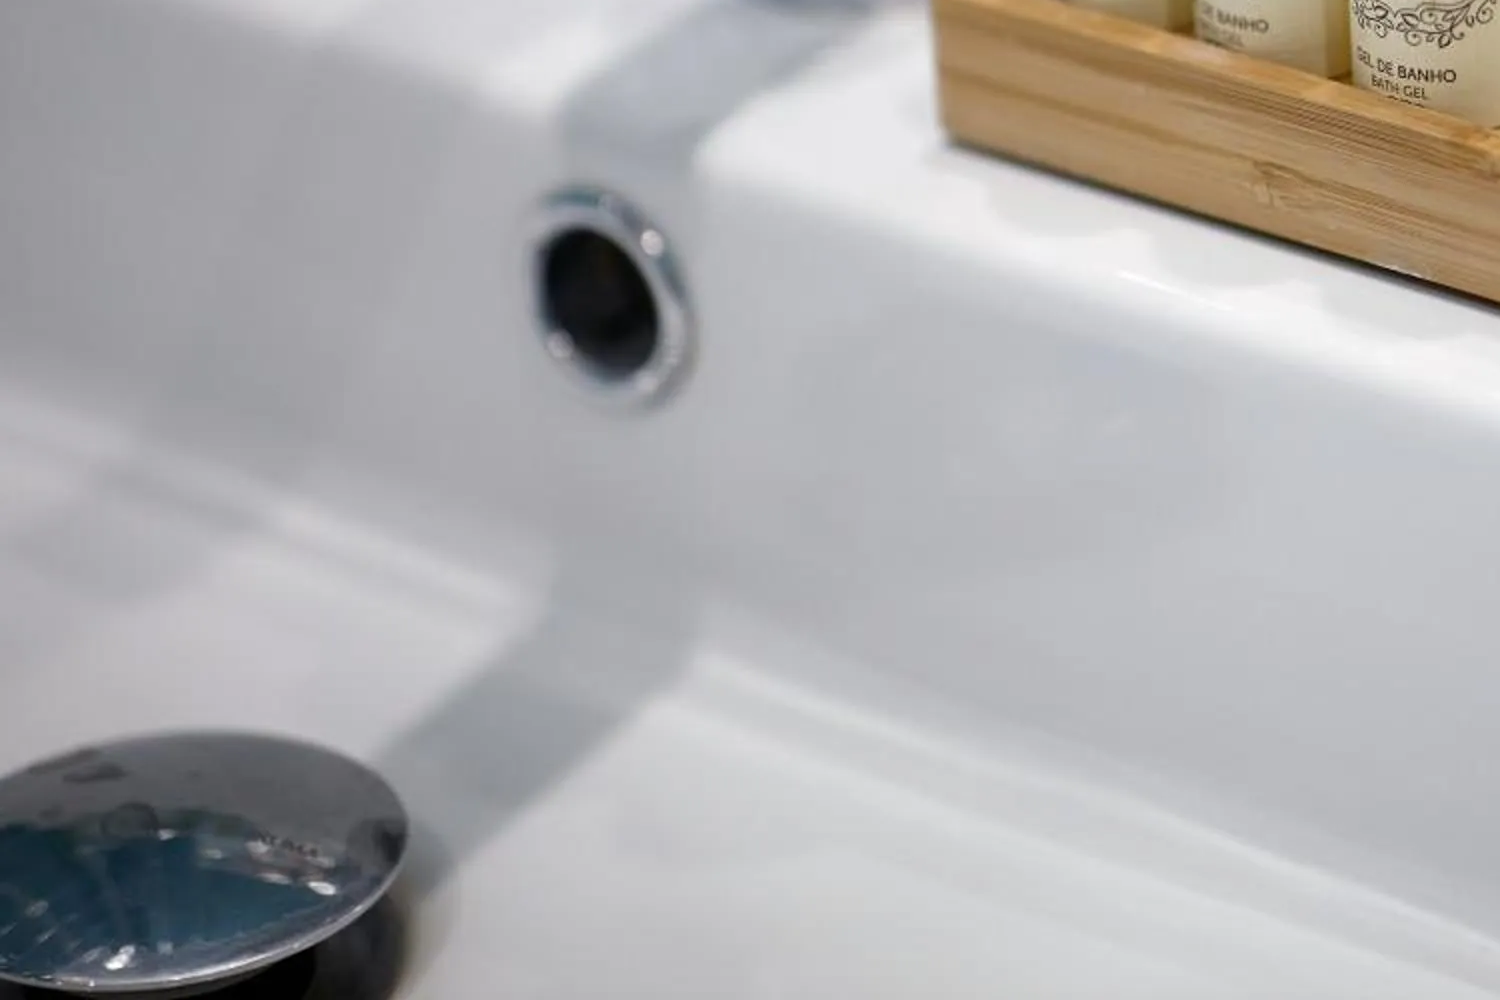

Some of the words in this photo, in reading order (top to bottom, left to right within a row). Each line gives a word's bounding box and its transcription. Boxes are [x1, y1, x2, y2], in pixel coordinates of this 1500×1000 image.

[1376, 57, 1395, 76] DE
[1397, 65, 1457, 83] BANHO
[1370, 74, 1400, 95] BATH
[1402, 84, 1430, 101] GEL
